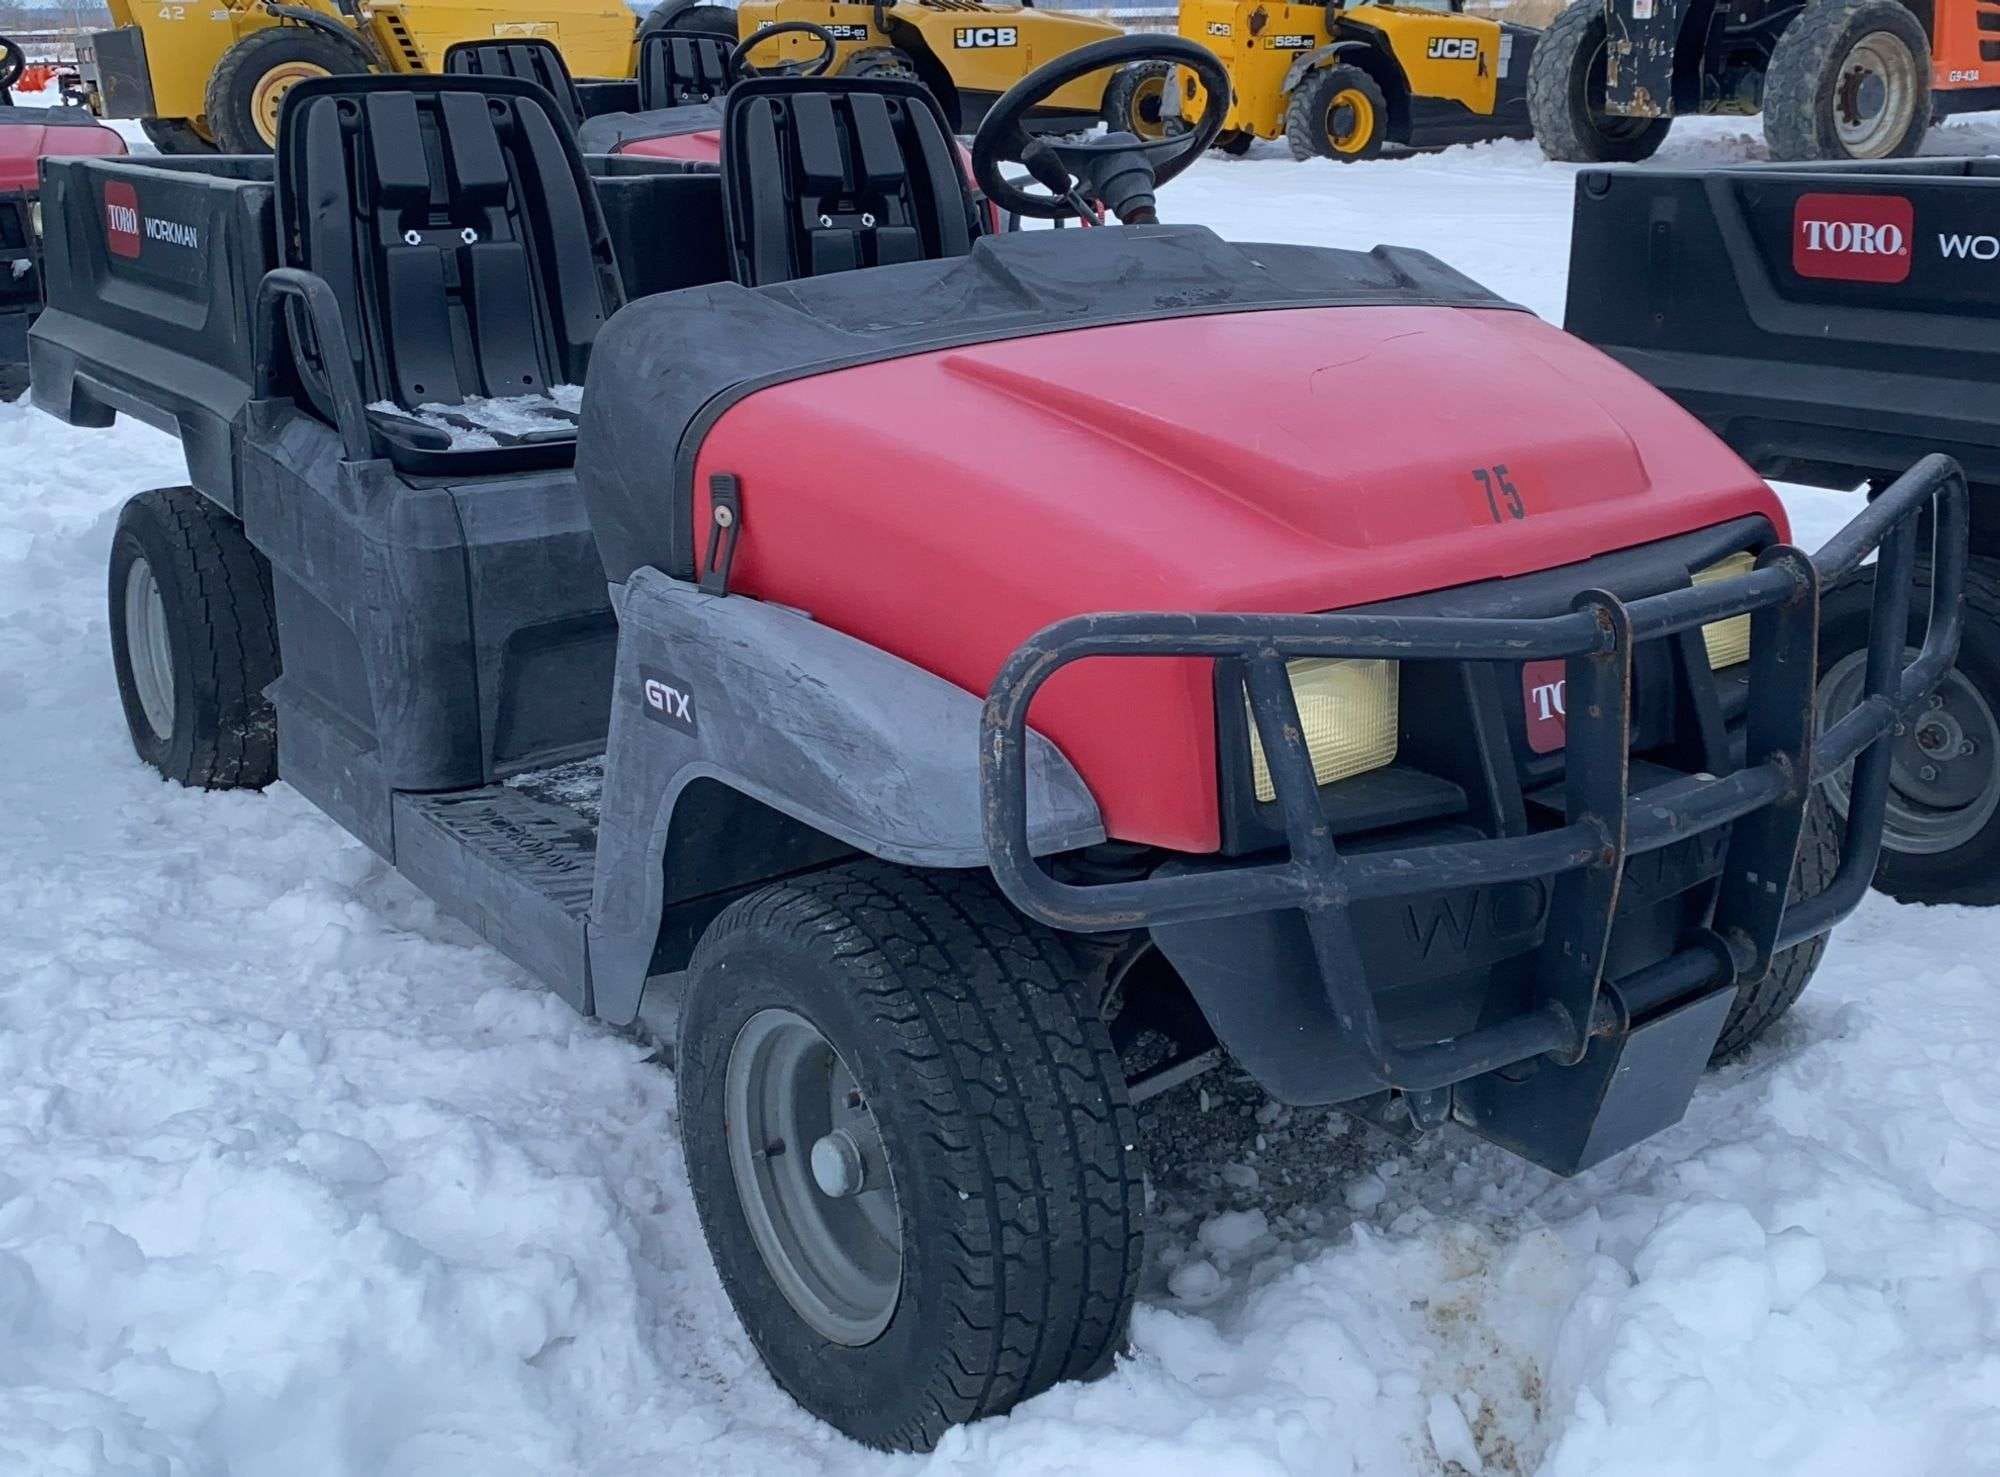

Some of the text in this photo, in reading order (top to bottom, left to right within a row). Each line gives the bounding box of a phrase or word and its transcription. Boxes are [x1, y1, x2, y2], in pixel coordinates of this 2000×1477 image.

[956, 28, 1017, 48] JCB
[1208, 23, 1231, 36] JCB
[1428, 38, 1478, 59] JCB
[107, 203, 198, 249] TORO WORKMAN
[1802, 220, 1904, 256] TORO
[1471, 464, 1525, 523] 75
[645, 678, 692, 723] GTX
[1531, 679, 1566, 720] TO
